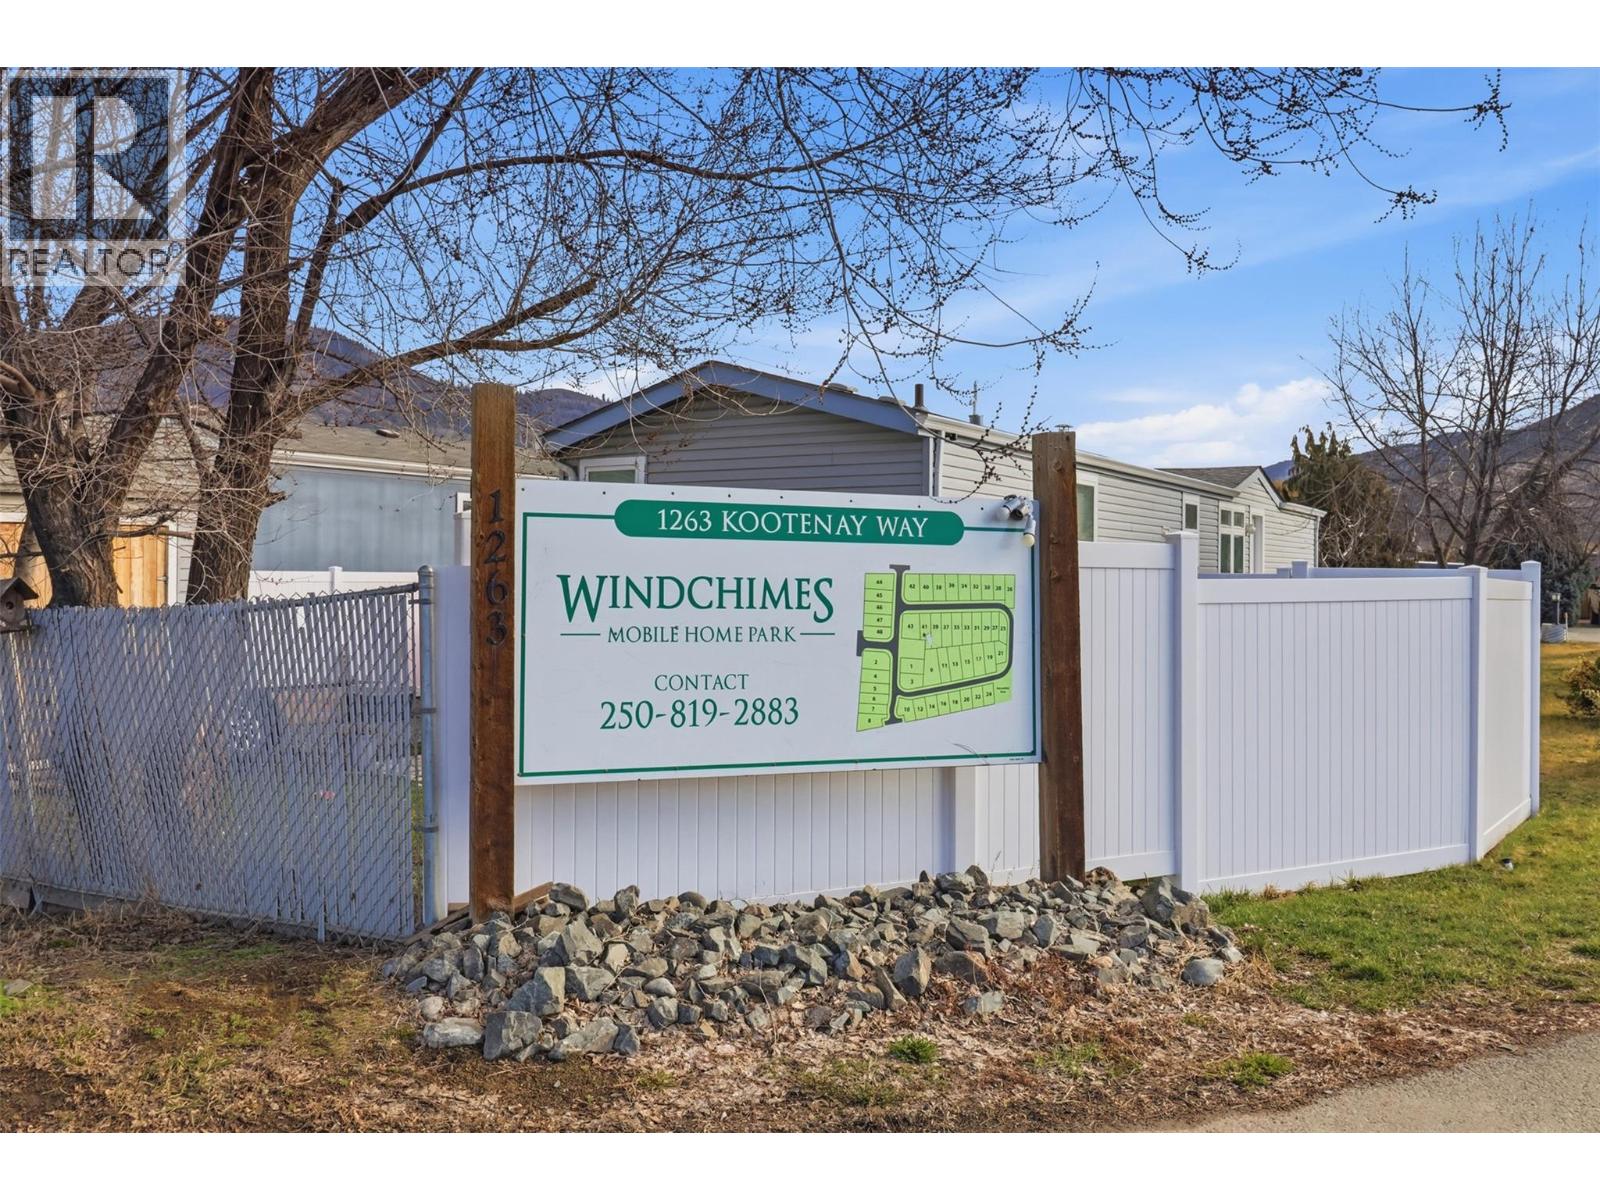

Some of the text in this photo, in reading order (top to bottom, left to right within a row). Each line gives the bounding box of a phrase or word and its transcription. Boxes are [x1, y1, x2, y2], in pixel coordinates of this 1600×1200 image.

[657, 509, 929, 538] 1263 KOOTENAY WAY
[484, 489, 508, 646] 1263
[556, 574, 834, 624] WINDCHIMES
[607, 625, 797, 643] MOBILE HOME PARK
[654, 673, 750, 692] CONTACT
[599, 696, 799, 730] 250-819-2883
